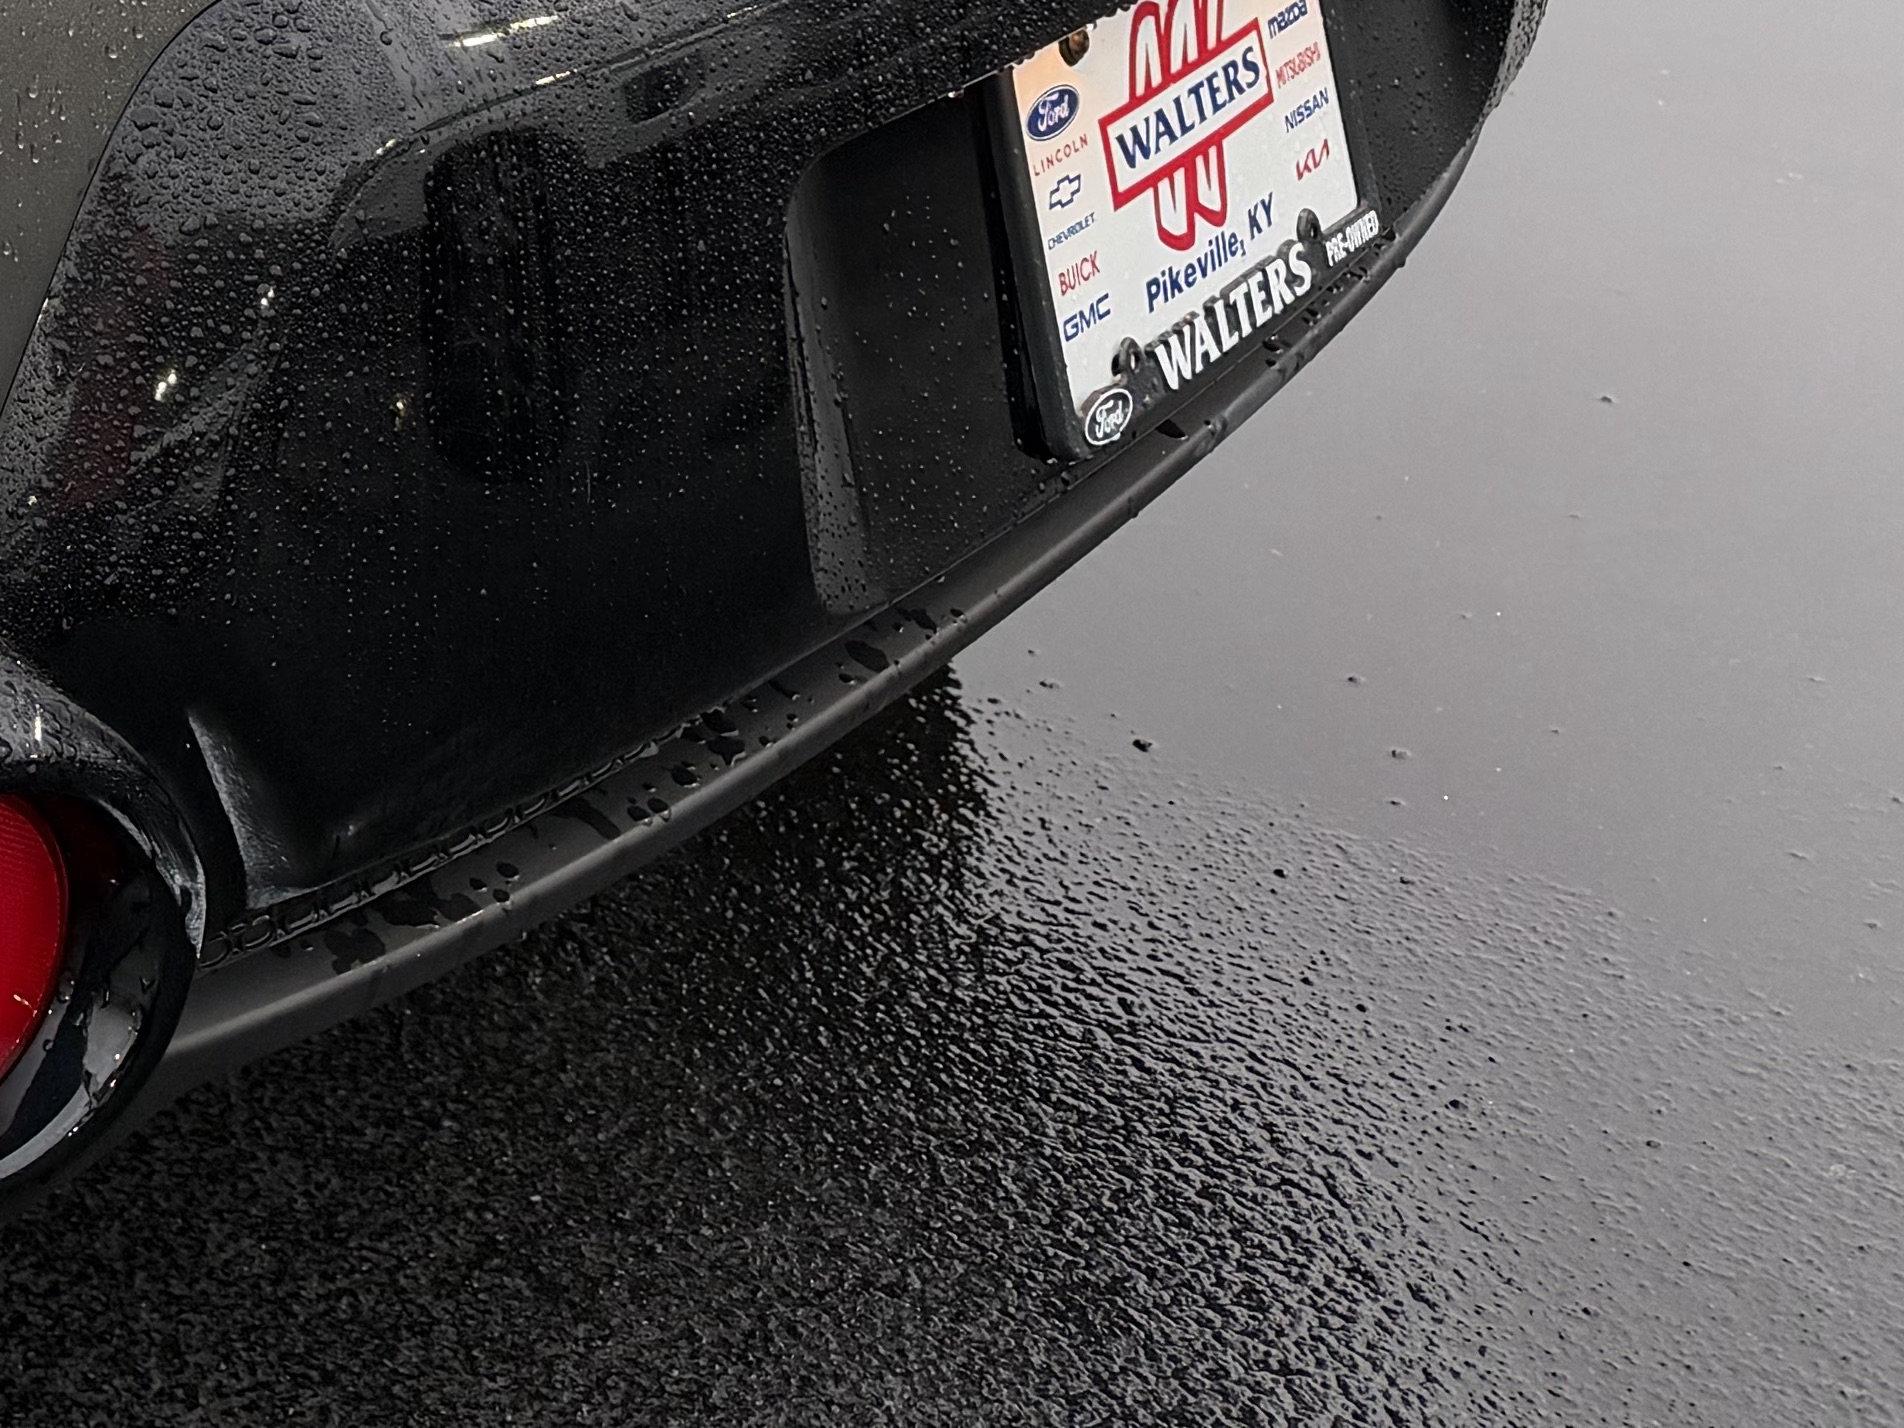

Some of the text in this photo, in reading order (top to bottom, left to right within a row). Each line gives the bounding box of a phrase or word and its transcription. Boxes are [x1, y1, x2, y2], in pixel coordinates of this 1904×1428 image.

[1275, 41, 1321, 89] MITSUBISHI
[1037, 91, 1070, 132] Ford
[1116, 45, 1260, 168] WALTERS
[1285, 88, 1329, 133] NISSAN
[1033, 134, 1089, 177] LINCOLN
[1296, 138, 1330, 181] KIA
[1048, 212, 1096, 250] CHEVROLET
[1145, 191, 1274, 314] Pikeville, KY
[1058, 250, 1101, 296] BUICK
[1063, 292, 1111, 342] GMC
[1154, 209, 1380, 390] WALTERS PRE-OWNED
